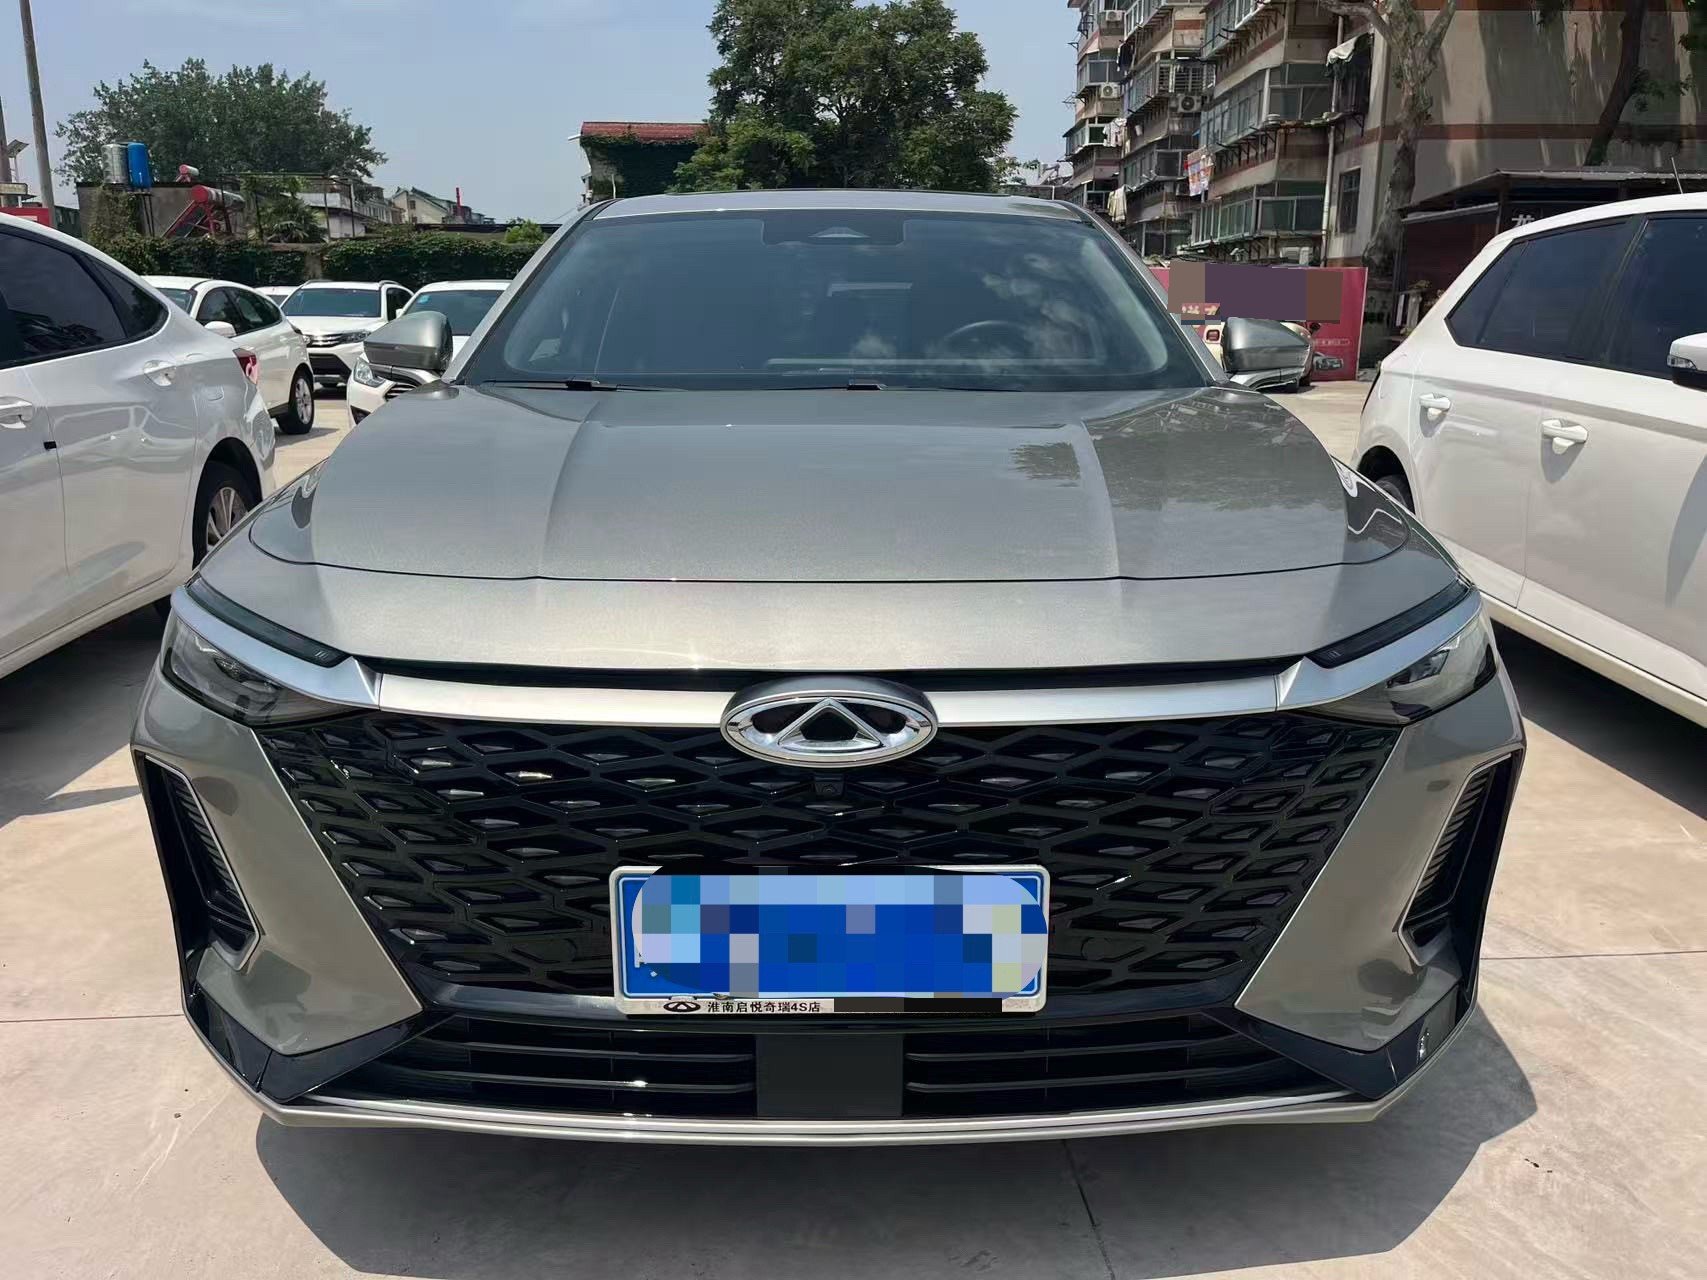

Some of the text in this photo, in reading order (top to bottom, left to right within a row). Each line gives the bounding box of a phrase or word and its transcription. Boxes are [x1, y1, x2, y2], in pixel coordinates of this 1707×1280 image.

[707, 1001, 821, 1013] 淮南启悦奇瑞4S店
